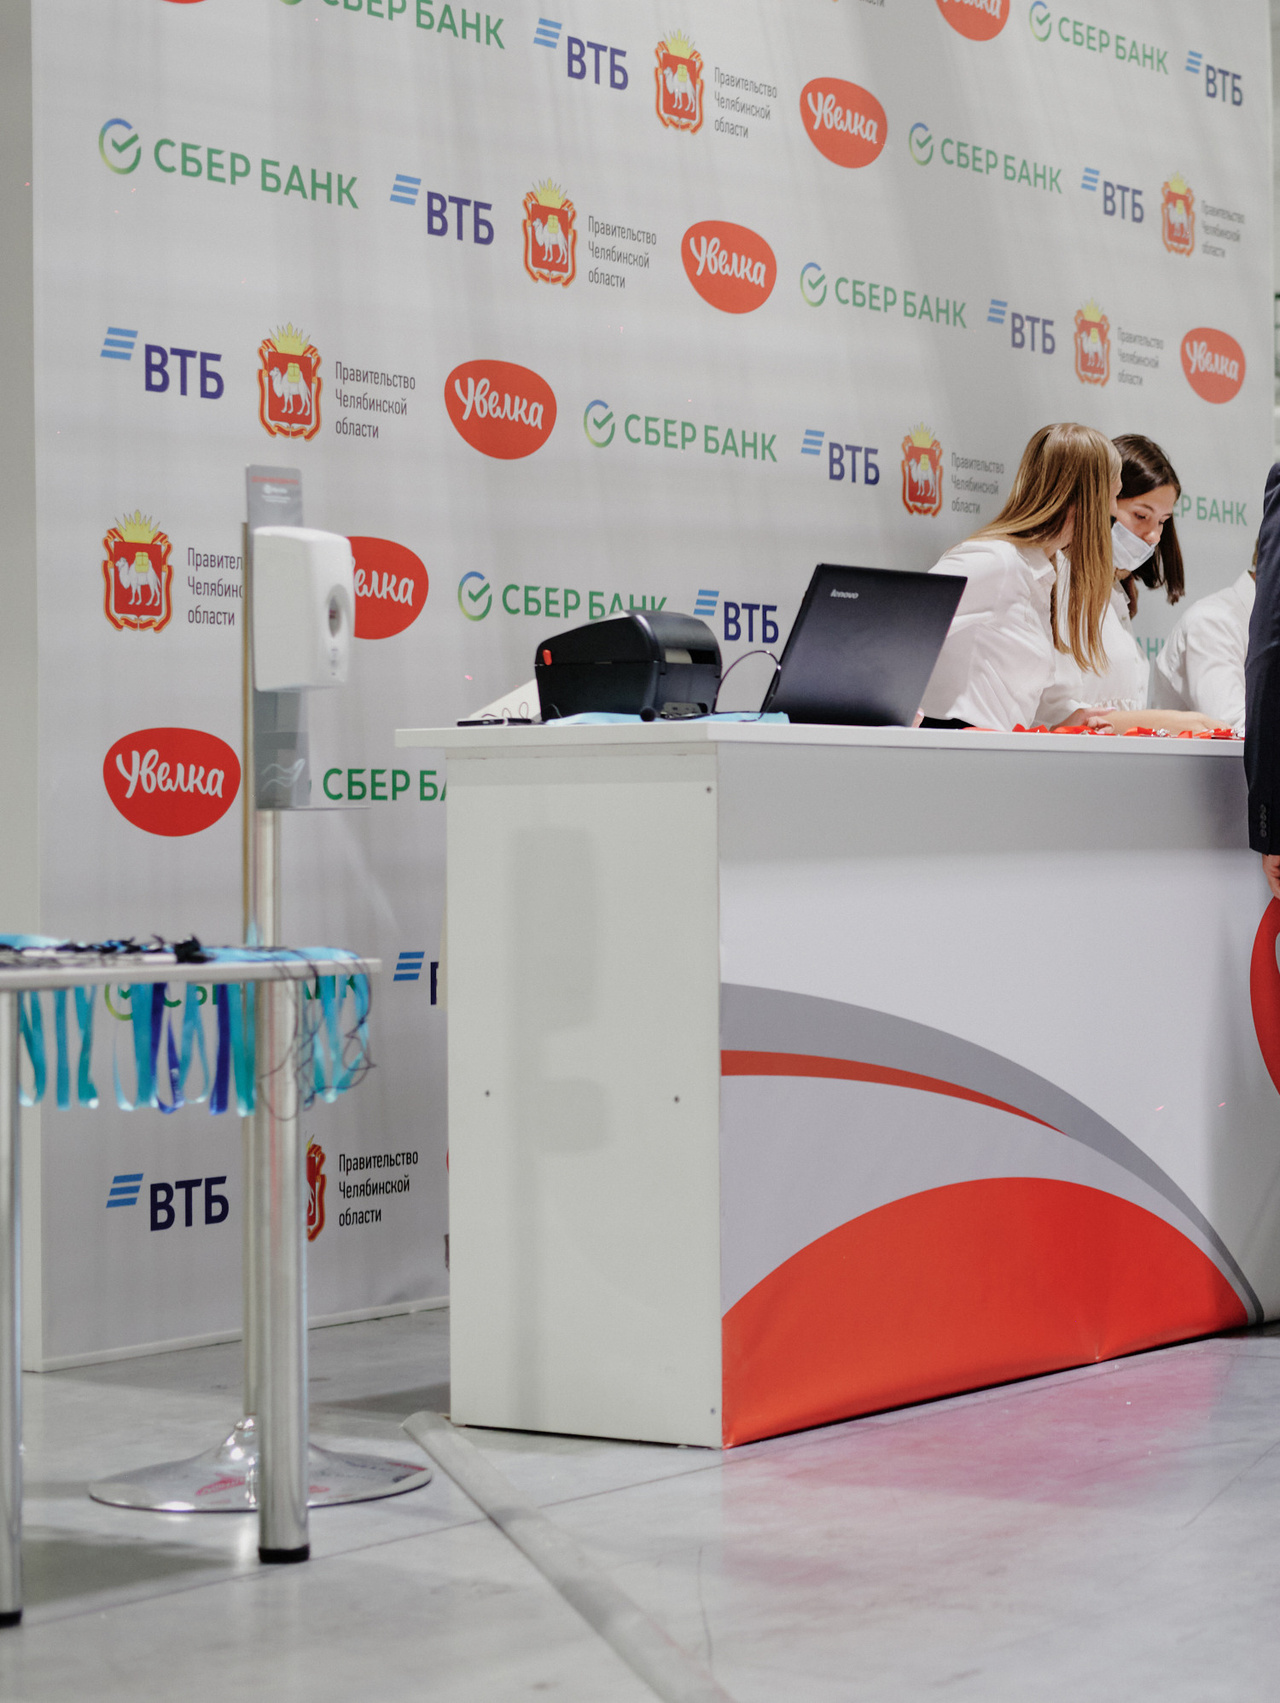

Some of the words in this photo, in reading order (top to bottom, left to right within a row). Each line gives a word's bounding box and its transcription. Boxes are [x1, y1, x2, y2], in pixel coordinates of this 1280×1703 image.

[416, 0, 504, 49] БАНК
[568, 36, 628, 90] ВТБ
[1059, 17, 1110, 53] СБЕР
[1116, 35, 1168, 74] БАНК
[715, 67, 777, 99] Правительство
[1206, 65, 1243, 106] ВТБ
[715, 90, 771, 121] Челябинской
[808, 92, 877, 143] Увелка
[715, 117, 748, 138] области
[154, 139, 250, 185] СБЕР
[262, 159, 358, 208] БАНК
[941, 138, 997, 174] СБЕР
[1004, 155, 1061, 193] БАНК
[427, 191, 494, 245] ВТБ
[1104, 181, 1144, 223] ВТБ
[589, 216, 656, 245] Правительство
[589, 240, 650, 268] Челябинской
[690, 237, 766, 287] Увелка
[589, 267, 625, 288] области
[835, 277, 897, 312] СБЕР
[904, 291, 966, 328] БАНК
[1011, 312, 1055, 354] ВТБ
[145, 344, 224, 399] ВТБ
[336, 361, 415, 390] Правительство
[1186, 341, 1238, 380] Увелка
[336, 388, 408, 415] Челябинской
[455, 378, 543, 429] Увелка
[336, 417, 378, 438] области
[625, 414, 696, 449] СБЕР
[704, 425, 777, 462] БАНК
[829, 442, 880, 485] ВТБ
[952, 452, 1004, 474] Правительство
[952, 476, 999, 496] Челябинской
[952, 497, 982, 515] области
[1197, 497, 1247, 526] БАНК
[188, 548, 242, 571] Правител
[353, 560, 414, 606] елка
[502, 584, 580, 618] СБЕР
[831, 589, 858, 599] lenovo
[188, 605, 234, 625] области
[724, 602, 779, 643] ВТБ
[116, 749, 224, 798] Увелка
[323, 768, 410, 800] СБЕР
[339, 1150, 418, 1174] Правительство
[150, 1176, 229, 1231] ВТБ
[339, 1175, 409, 1198] Челябинской
[339, 1208, 381, 1226] области
